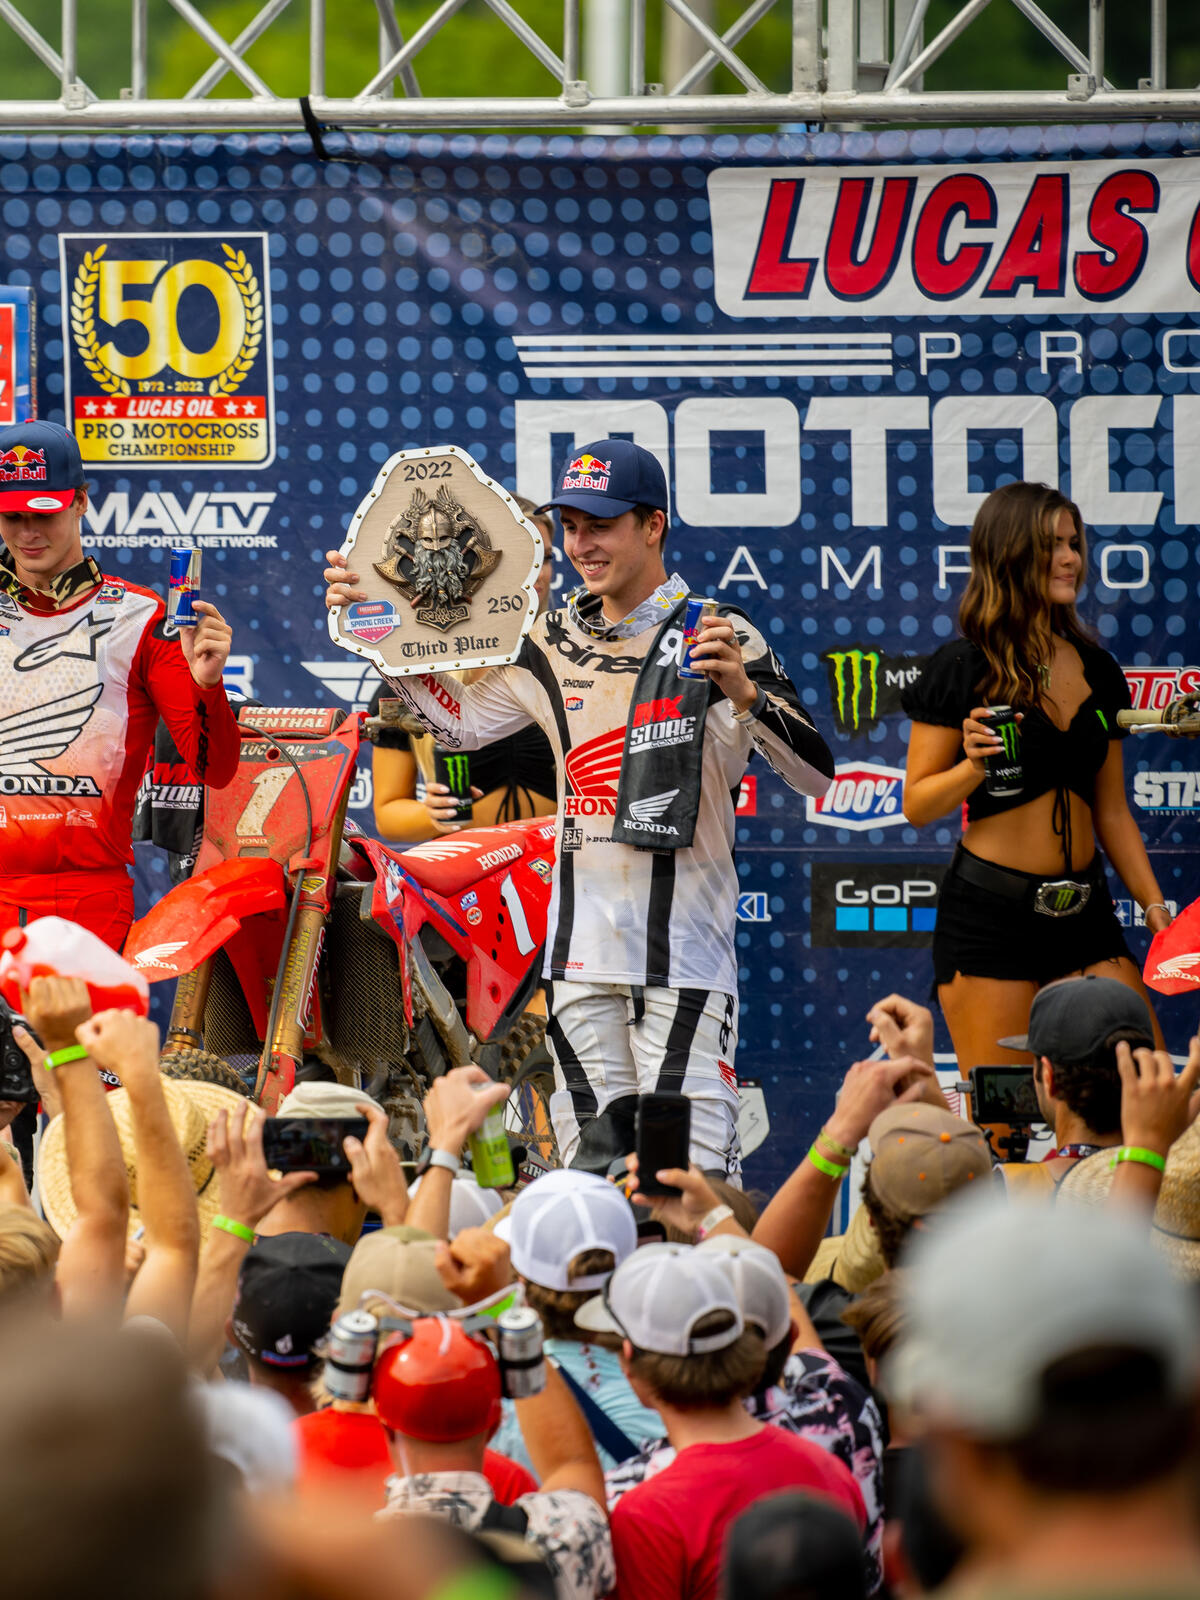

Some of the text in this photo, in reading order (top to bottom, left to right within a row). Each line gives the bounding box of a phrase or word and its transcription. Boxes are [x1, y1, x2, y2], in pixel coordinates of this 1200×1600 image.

[743, 169, 1160, 303] LUCAS
[96, 259, 246, 380] 50
[919, 328, 1200, 376] PRO
[138, 381, 165, 392] 1972
[175, 381, 204, 392] 2022
[126, 399, 215, 417] LUCAS OIL
[82, 423, 260, 439] PRO MOTOCROSS
[108, 443, 236, 457] CHAMPIONSHIP
[513, 394, 1200, 529] MOTOC
[21, 466, 47, 481] Bull
[403, 461, 453, 482] 2022
[562, 475, 610, 492] Red Bull
[197, 536, 278, 548] NETWORK
[487, 594, 523, 615] 250
[350, 616, 394, 628] SPRING CREEK
[357, 626, 389, 634] NATIONAL
[401, 635, 500, 660] Third Place
[562, 679, 594, 689] SHOWA
[632, 695, 684, 728] MX
[244, 718, 326, 728] RENTHAL
[630, 717, 697, 746] STORE
[235, 765, 301, 837] 1
[821, 779, 897, 815] 100%
[565, 798, 618, 816] HON
[19, 812, 64, 822] DUNLOP
[623, 820, 680, 837] HONDA
[476, 843, 524, 871] HONDA
[835, 879, 937, 905] GoP
[501, 871, 537, 957] 1
